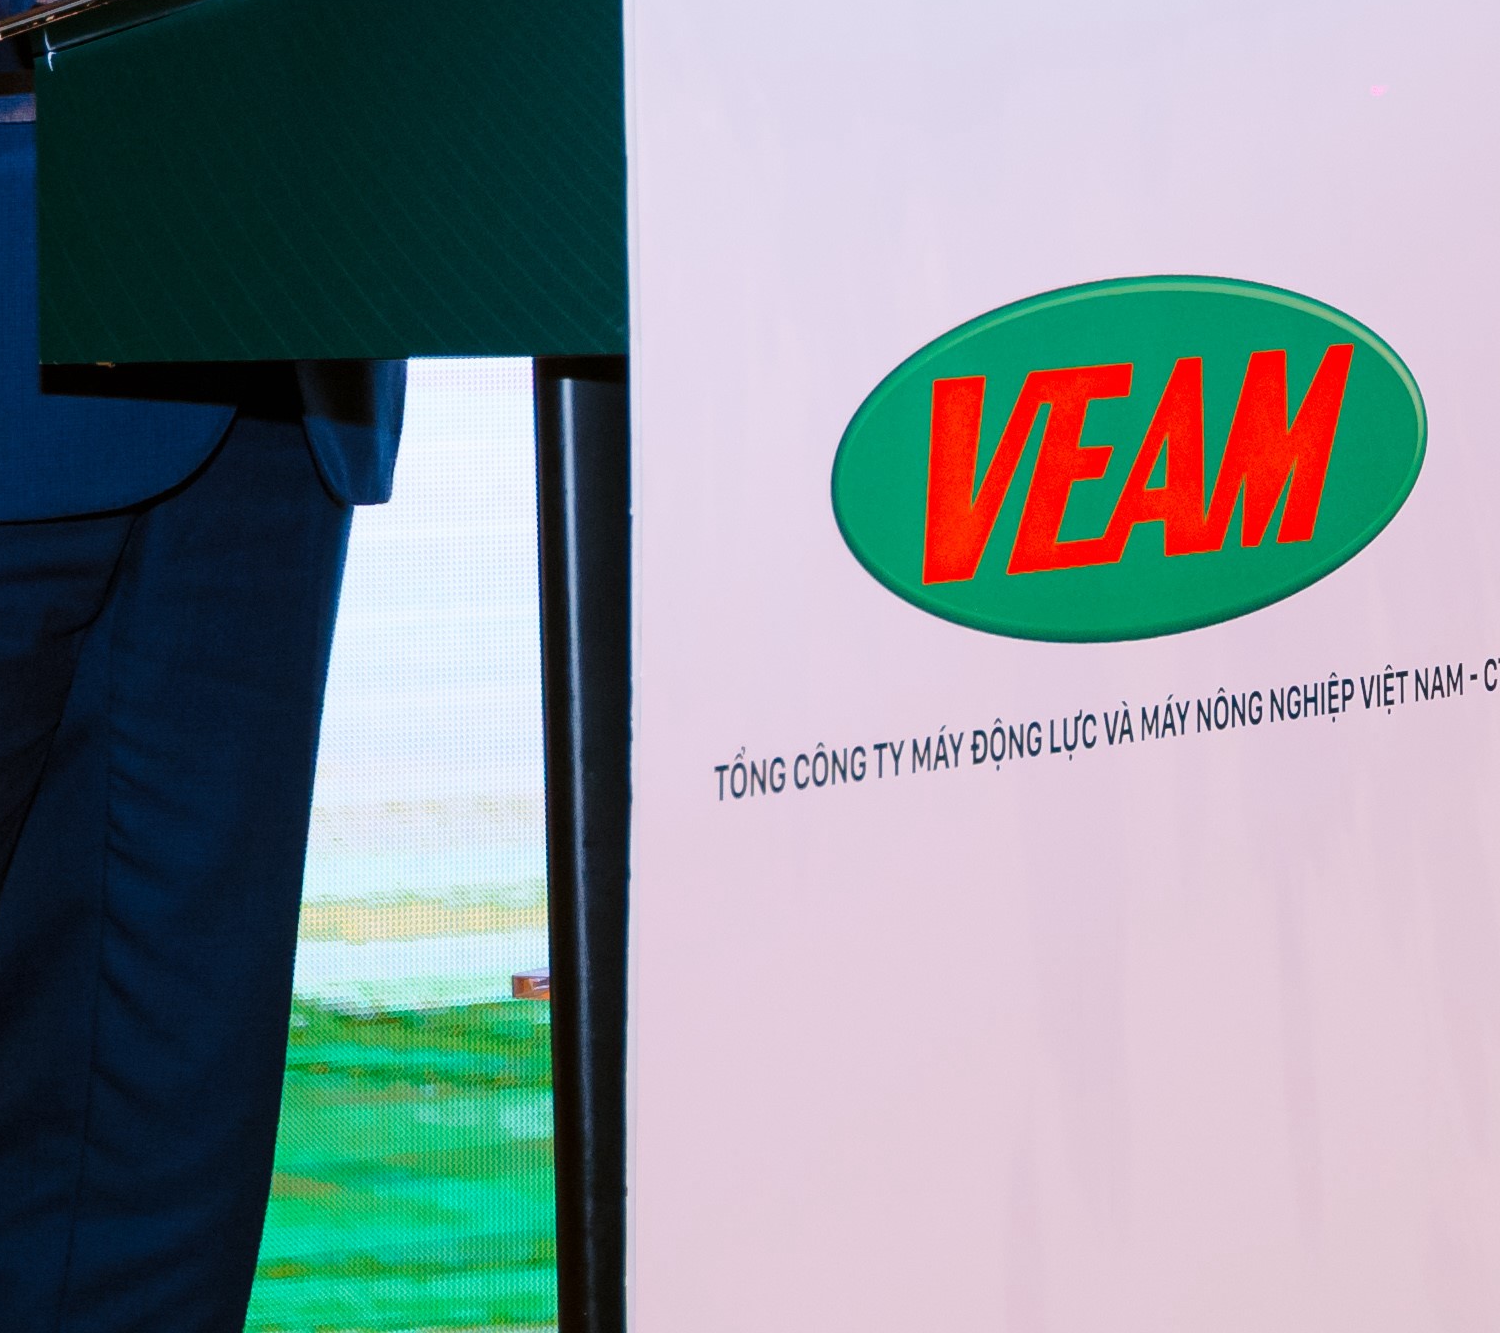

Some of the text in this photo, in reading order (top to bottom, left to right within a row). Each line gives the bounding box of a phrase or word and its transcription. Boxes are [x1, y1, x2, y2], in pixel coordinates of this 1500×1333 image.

[921, 343, 1355, 586] VEAM
[714, 746, 787, 802] TỔNG
[793, 742, 867, 791] CÔNG
[873, 740, 905, 779] TY
[911, 725, 964, 774] MÁY
[970, 718, 1043, 772] ĐỘNG
[1049, 709, 1098, 762] LỰC
[1103, 701, 1134, 746] VÀ
[1140, 694, 1191, 741] MÁY
[1196, 687, 1264, 733] NÔNG
[1270, 671, 1356, 724] NGHIỆP
[1359, 664, 1410, 715] VIỆT
[1414, 662, 1465, 702] NAM
